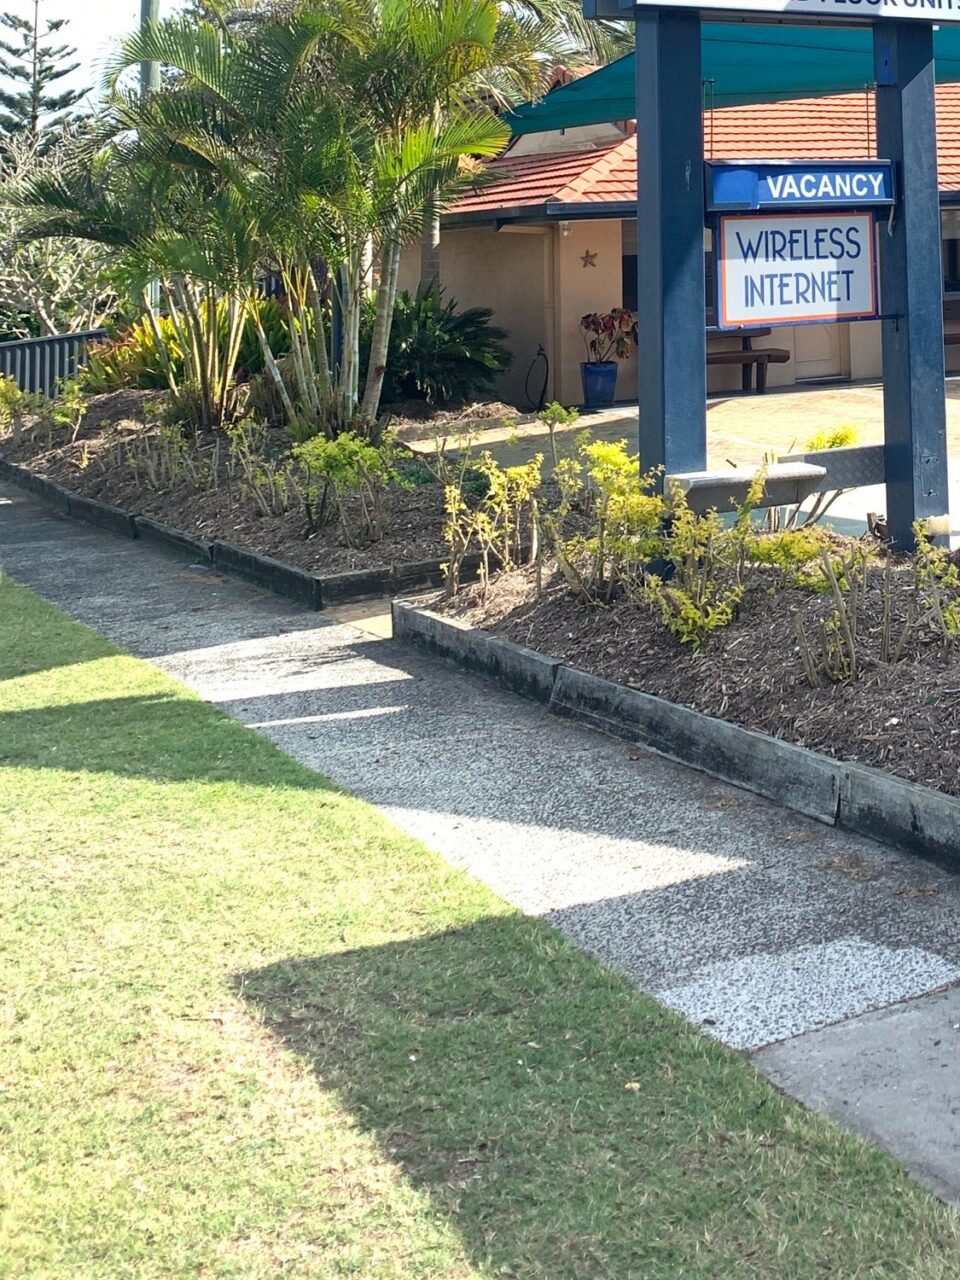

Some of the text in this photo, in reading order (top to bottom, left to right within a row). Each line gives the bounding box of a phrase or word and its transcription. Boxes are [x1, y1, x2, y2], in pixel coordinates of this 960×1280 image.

[766, 173, 884, 198] VACANCY
[736, 226, 861, 264] WIRELESS
[744, 270, 854, 308] INTERNET
